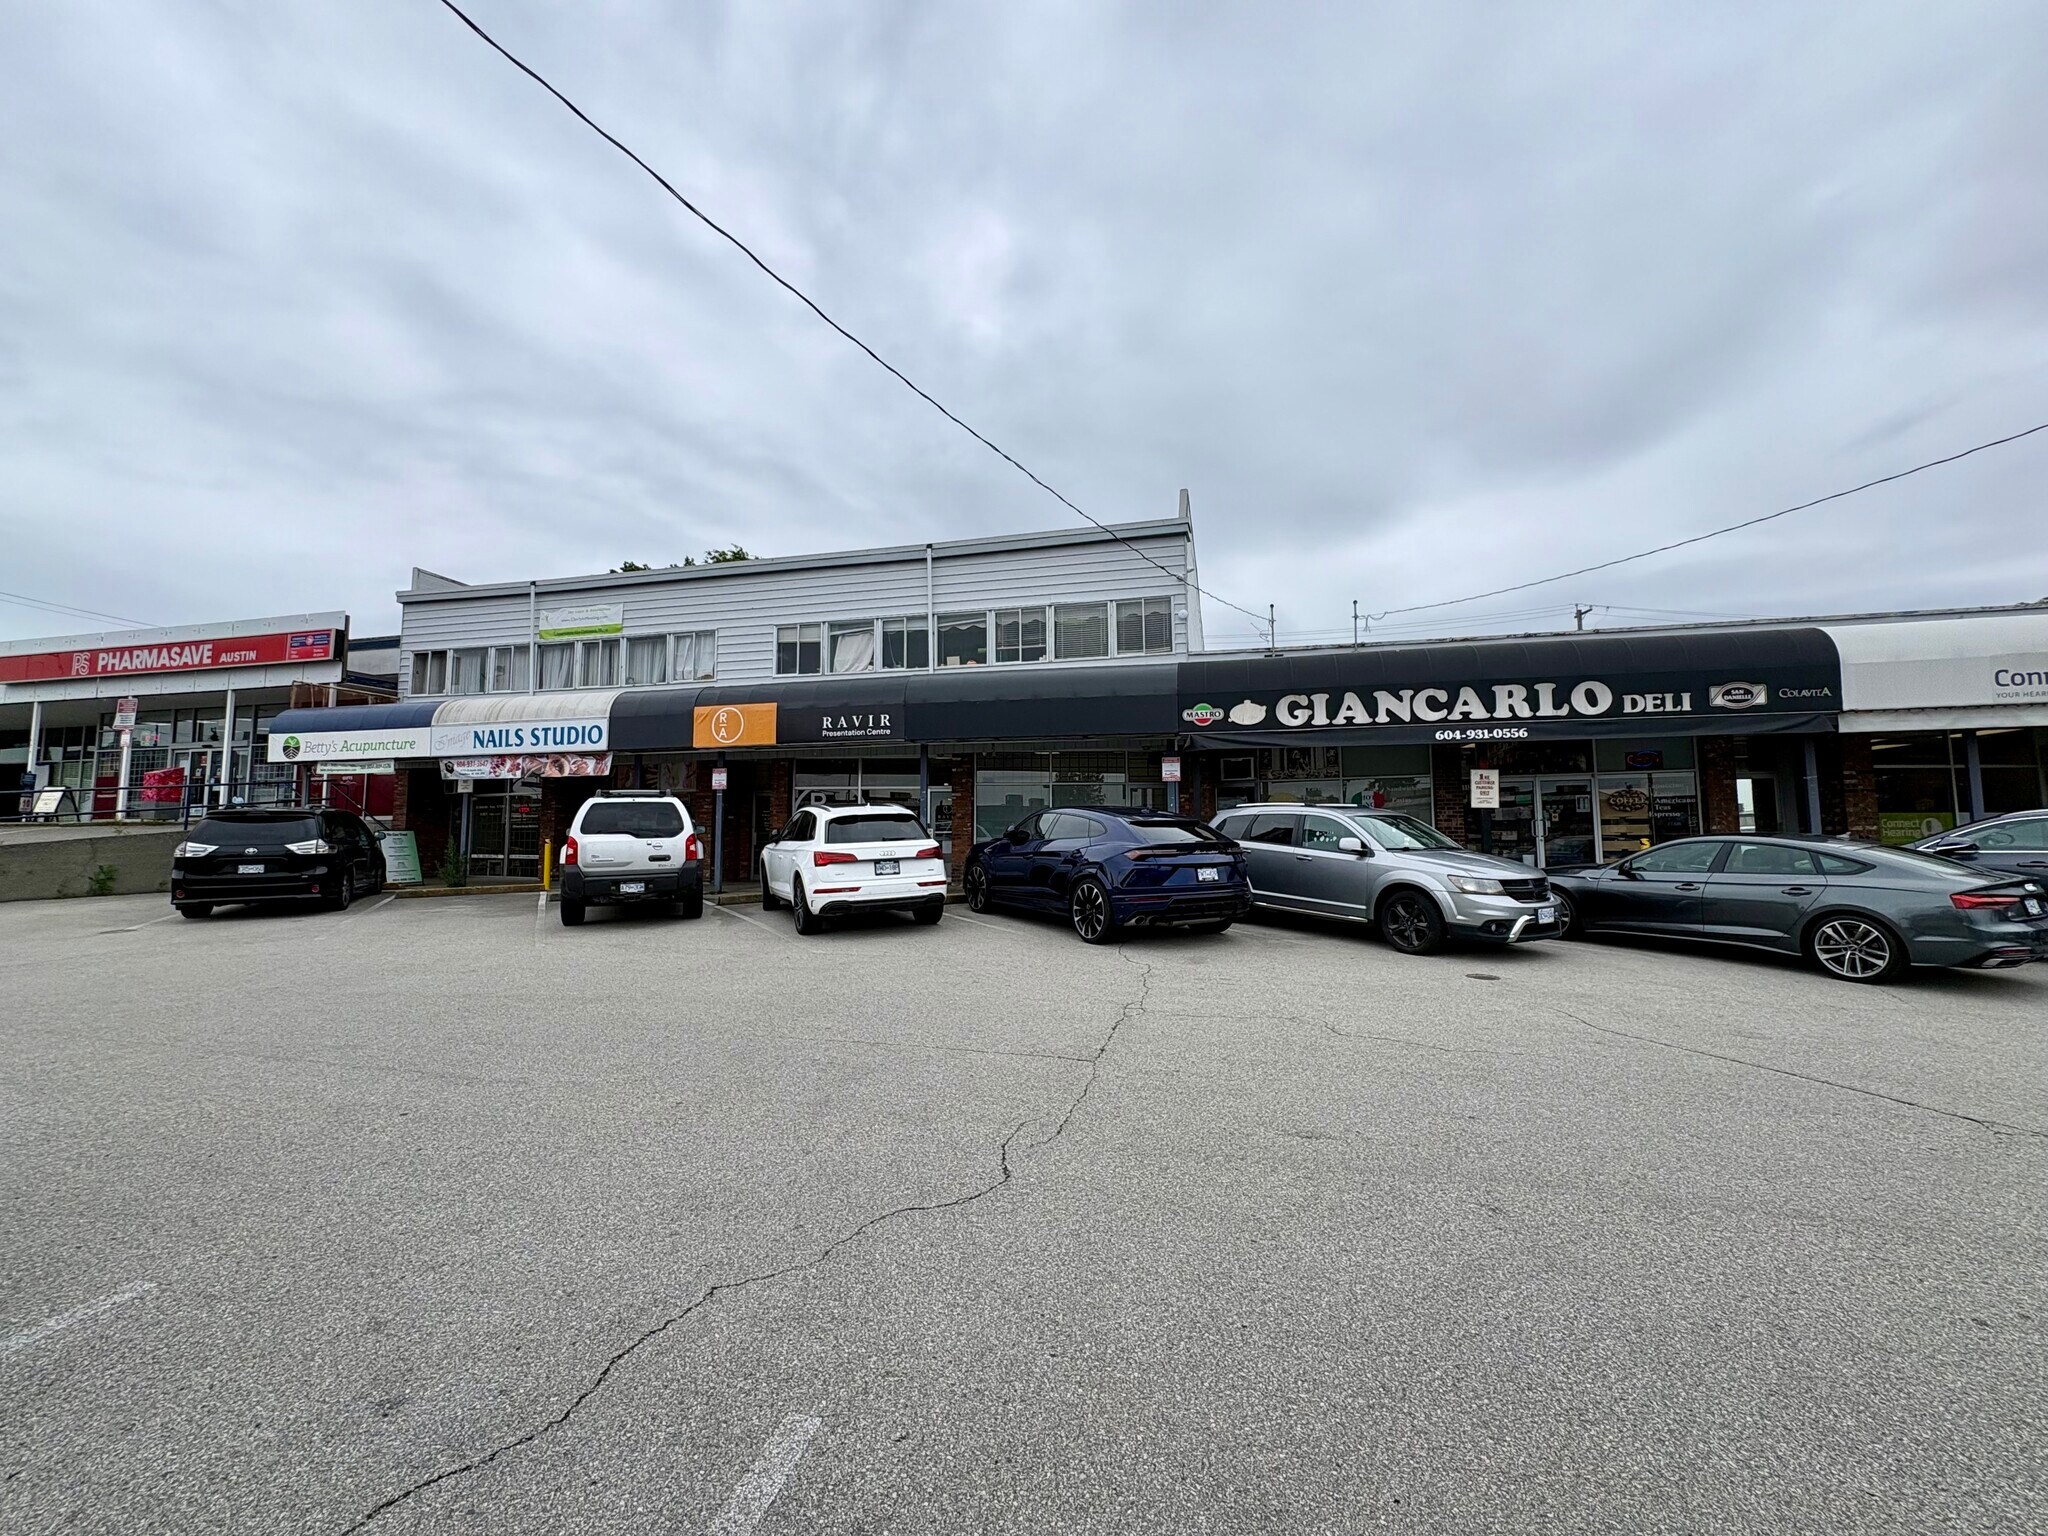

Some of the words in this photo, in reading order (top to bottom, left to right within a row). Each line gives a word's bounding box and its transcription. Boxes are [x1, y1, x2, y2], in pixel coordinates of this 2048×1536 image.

[97, 644, 214, 672] PHARMASAVE
[219, 650, 257, 664] AUSTIN
[1778, 687, 1832, 698] COLAVITA
[1996, 691, 2020, 699] YOUR
[2022, 690, 2048, 698] HEAR
[1275, 680, 1613, 727] GIANCARLO
[1622, 692, 1693, 714] DELI
[719, 712, 728, 723] R
[1186, 710, 1221, 718] MASTRO
[822, 714, 891, 729] RAVIR
[473, 728, 525, 749] NAILS
[530, 725, 603, 747] STUDIO
[719, 727, 728, 738] A
[822, 729, 866, 737] Presentation
[866, 728, 891, 736] Centre
[1435, 727, 1528, 742] 604-931-0556
[303, 740, 338, 757] Betty's
[340, 739, 416, 755] Acupuncture
[1881, 819, 1920, 828] Connect
[1882, 828, 1921, 838] Hearing
